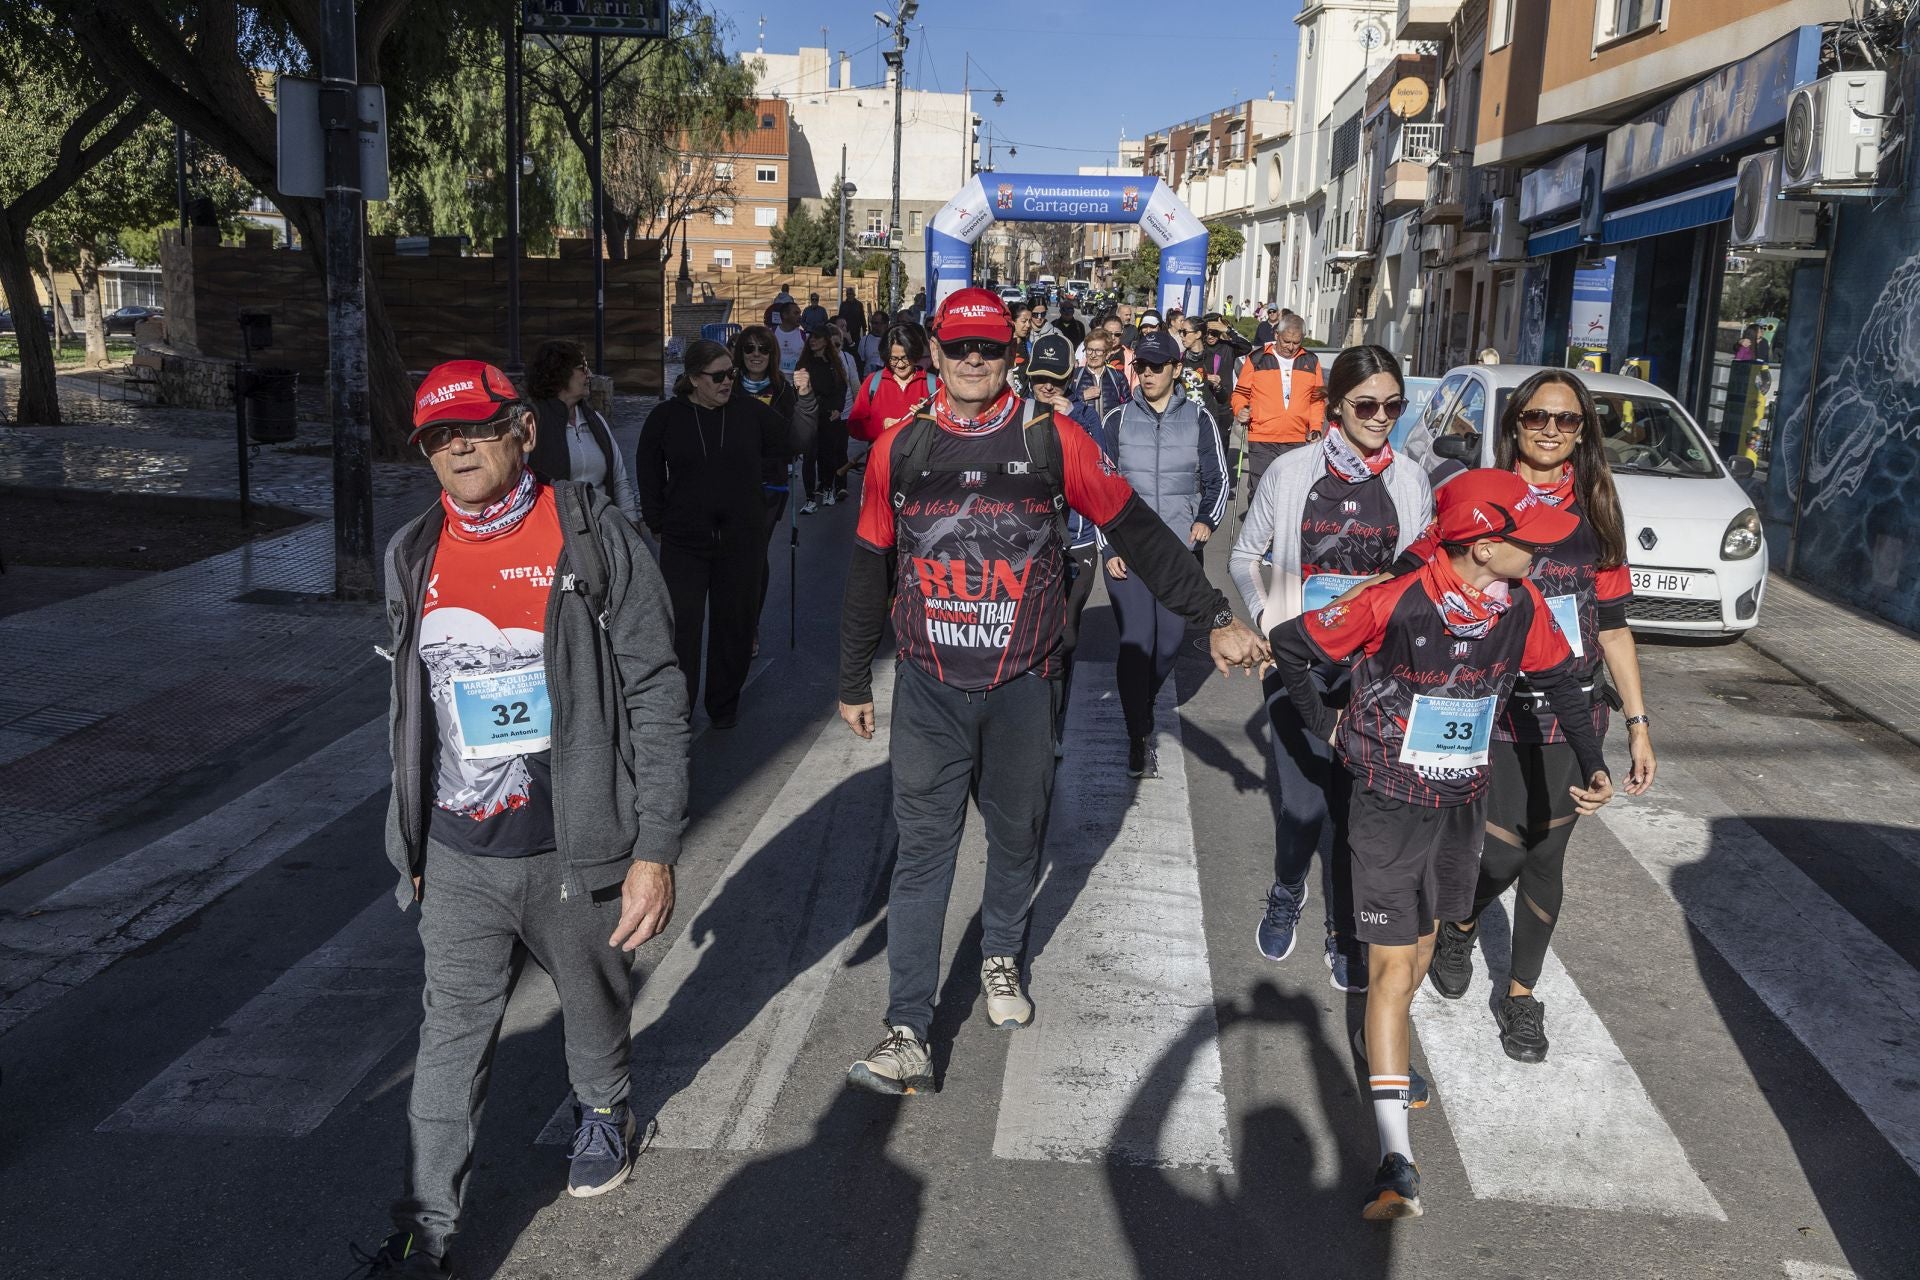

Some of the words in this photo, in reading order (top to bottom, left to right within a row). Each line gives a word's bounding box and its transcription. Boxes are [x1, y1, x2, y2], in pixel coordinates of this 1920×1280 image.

[1023, 185, 1110, 199] Ayuntamiento
[1023, 198, 1109, 215] Cartagena
[962, 213, 988, 238] Deportes
[1146, 215, 1170, 242] Deportes
[437, 381, 475, 397] ALEGRE
[430, 393, 456, 406] TRAIL
[924, 499, 960, 517] Vista
[964, 497, 1015, 518] Alegre
[1021, 498, 1051, 515] Trail
[1343, 500, 1357, 512] 10
[500, 566, 543, 580] VISTA
[911, 556, 1034, 600] RUN
[530, 577, 554, 588] TRA
[1631, 572, 1652, 589] 38
[1657, 574, 1690, 591] HBV
[925, 598, 979, 613] MOUNTAIN
[978, 602, 1017, 624] TRAIL
[926, 608, 978, 624] RUNNING
[927, 618, 1013, 648] HIKING
[1453, 641, 1468, 657] 10
[463, 679, 500, 691] MARCHA
[491, 701, 531, 727] 32
[491, 732, 509, 740] Juan
[510, 728, 539, 737] Antonio
[1443, 721, 1473, 740] 33
[1360, 911, 1388, 925] CWC
[1399, 1090, 1408, 1100] NI
